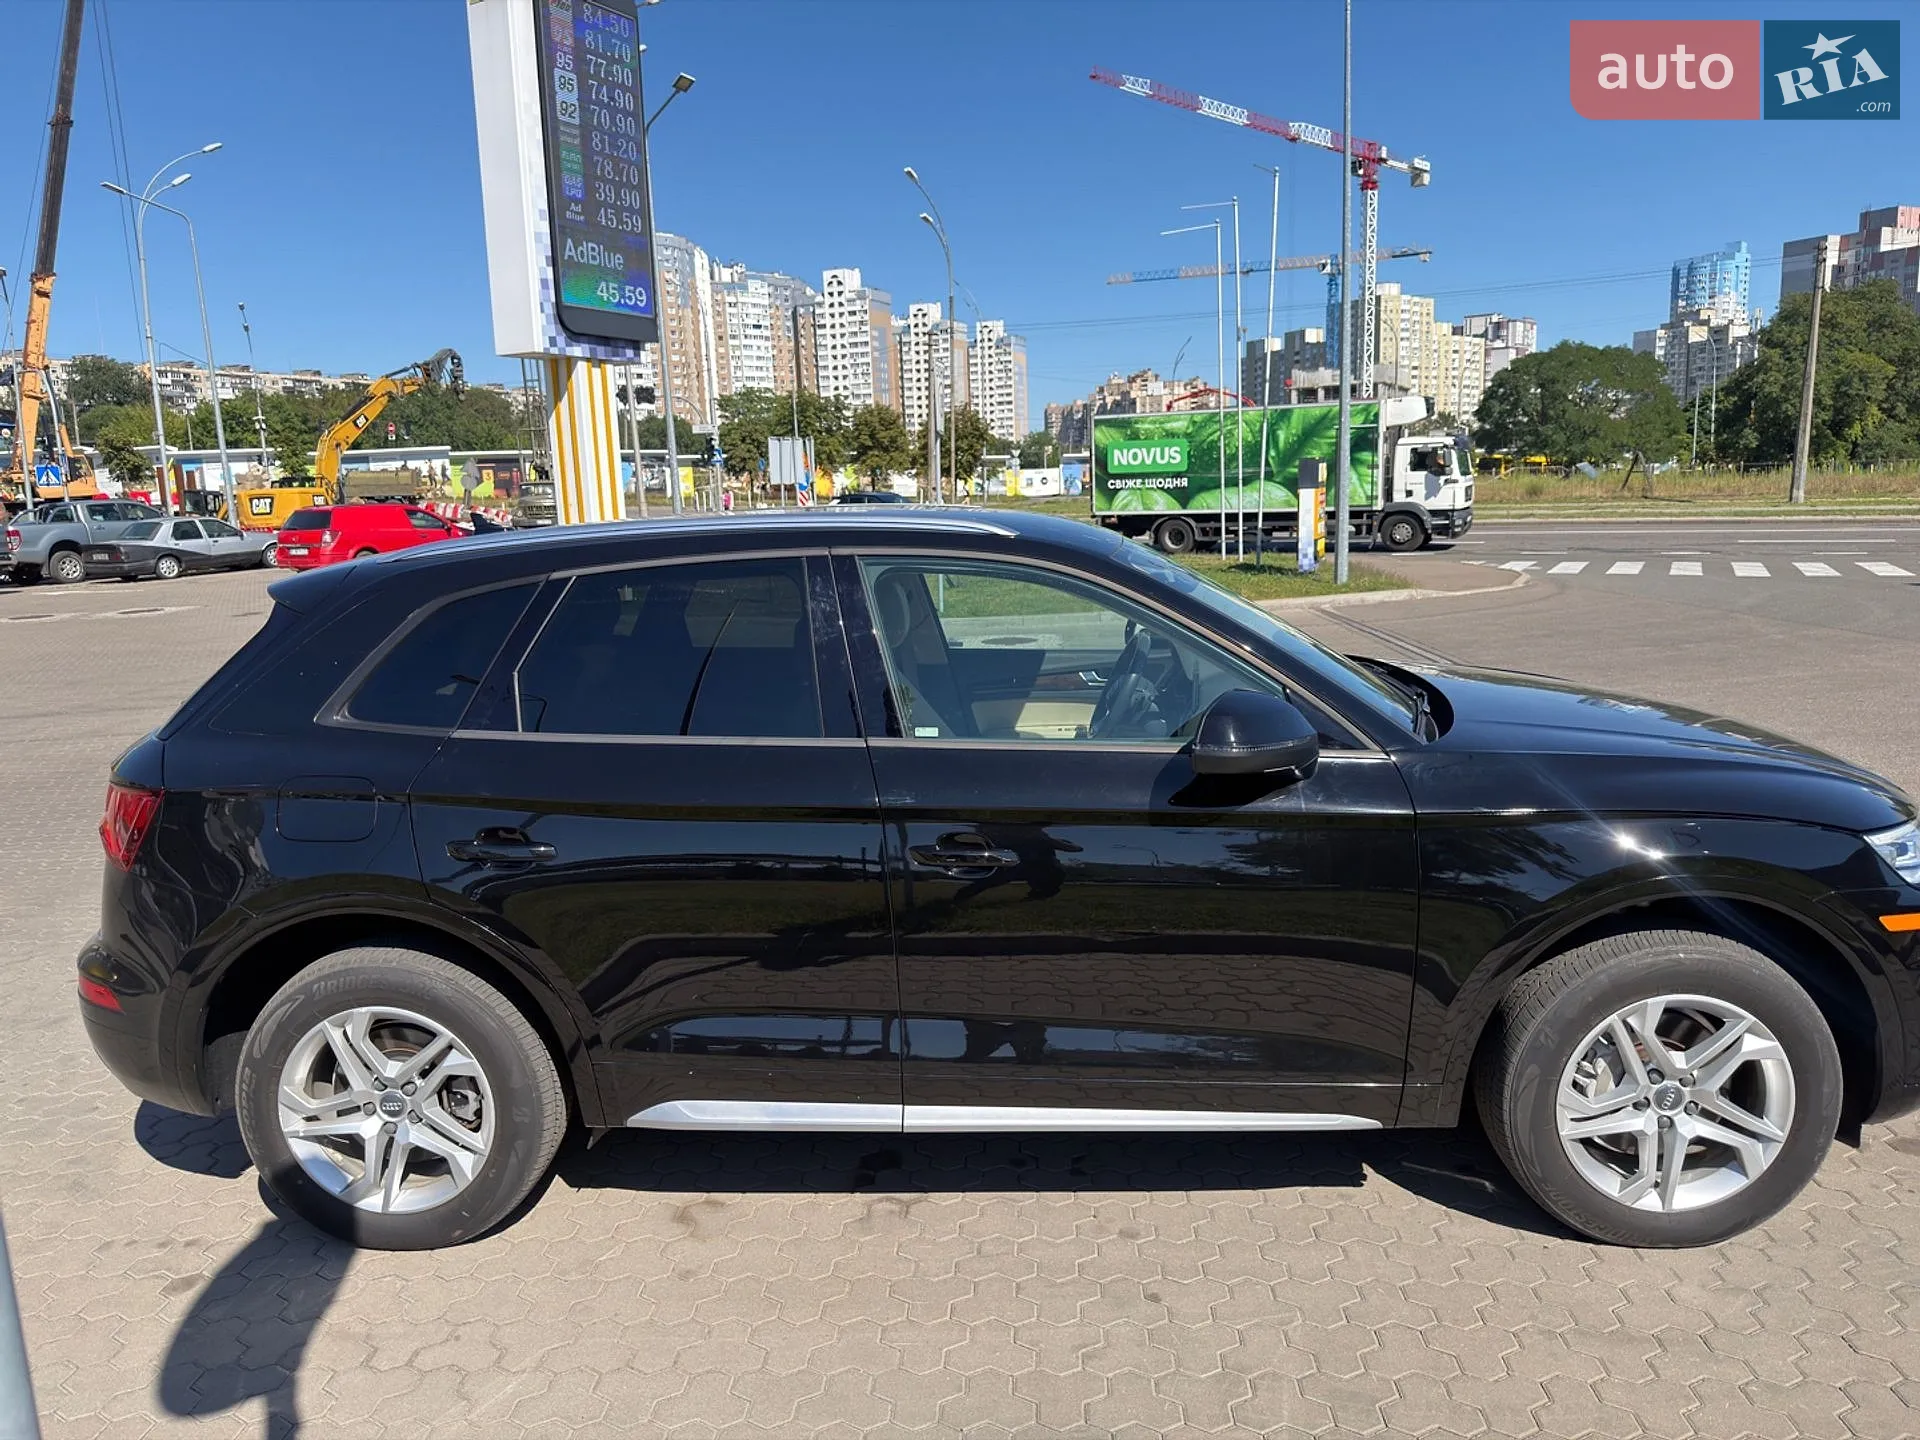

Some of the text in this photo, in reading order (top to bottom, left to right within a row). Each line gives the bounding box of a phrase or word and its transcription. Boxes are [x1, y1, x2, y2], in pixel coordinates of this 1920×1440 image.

[583, 3, 629, 38] 84.50
[585, 29, 631, 63] 81.70
[555, 51, 632, 88] 95 77.90
[558, 75, 633, 112] 95 74.90
[560, 100, 577, 119] 92
[590, 104, 635, 137] 70.90
[592, 130, 636, 161] 81.20
[593, 155, 638, 185] 78.70
[570, 202, 582, 212] Ad
[595, 181, 640, 209] 39.90
[566, 207, 642, 233] Blue 45.59
[564, 238, 624, 271] AdBlue
[597, 281, 647, 307] 45.59
[355, 414, 367, 428] CAT
[1113, 446, 1181, 466] NOVUS
[1107, 477, 1188, 489] СВІЖЕ ЩОДНЯ
[252, 498, 272, 514] CAT
[313, 495, 325, 505] CAT
